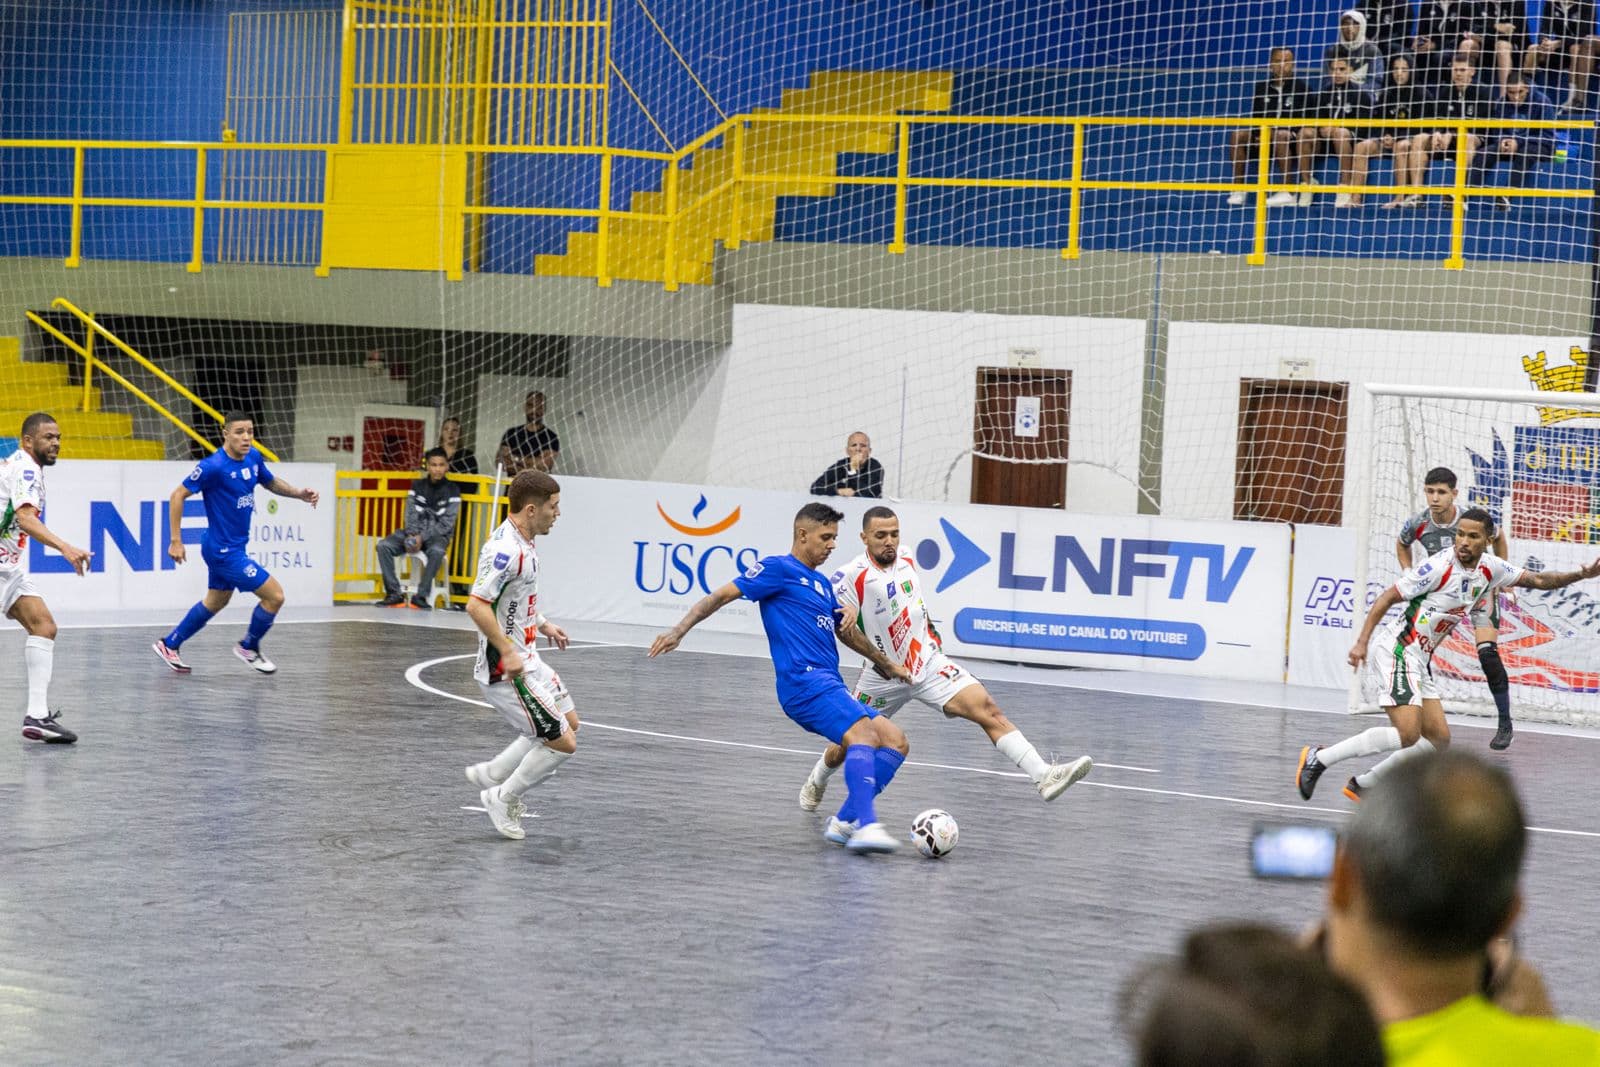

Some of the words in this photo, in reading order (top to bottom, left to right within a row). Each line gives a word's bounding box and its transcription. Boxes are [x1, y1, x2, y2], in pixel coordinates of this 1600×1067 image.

[254, 525, 305, 541] IONAL
[973, 618, 1047, 635] INSCREVA-SE
[1049, 624, 1067, 637] NO
[1068, 625, 1108, 640] CANAL
[1110, 628, 1127, 640] DO
[1129, 629, 1188, 645] YOUTUBE!
